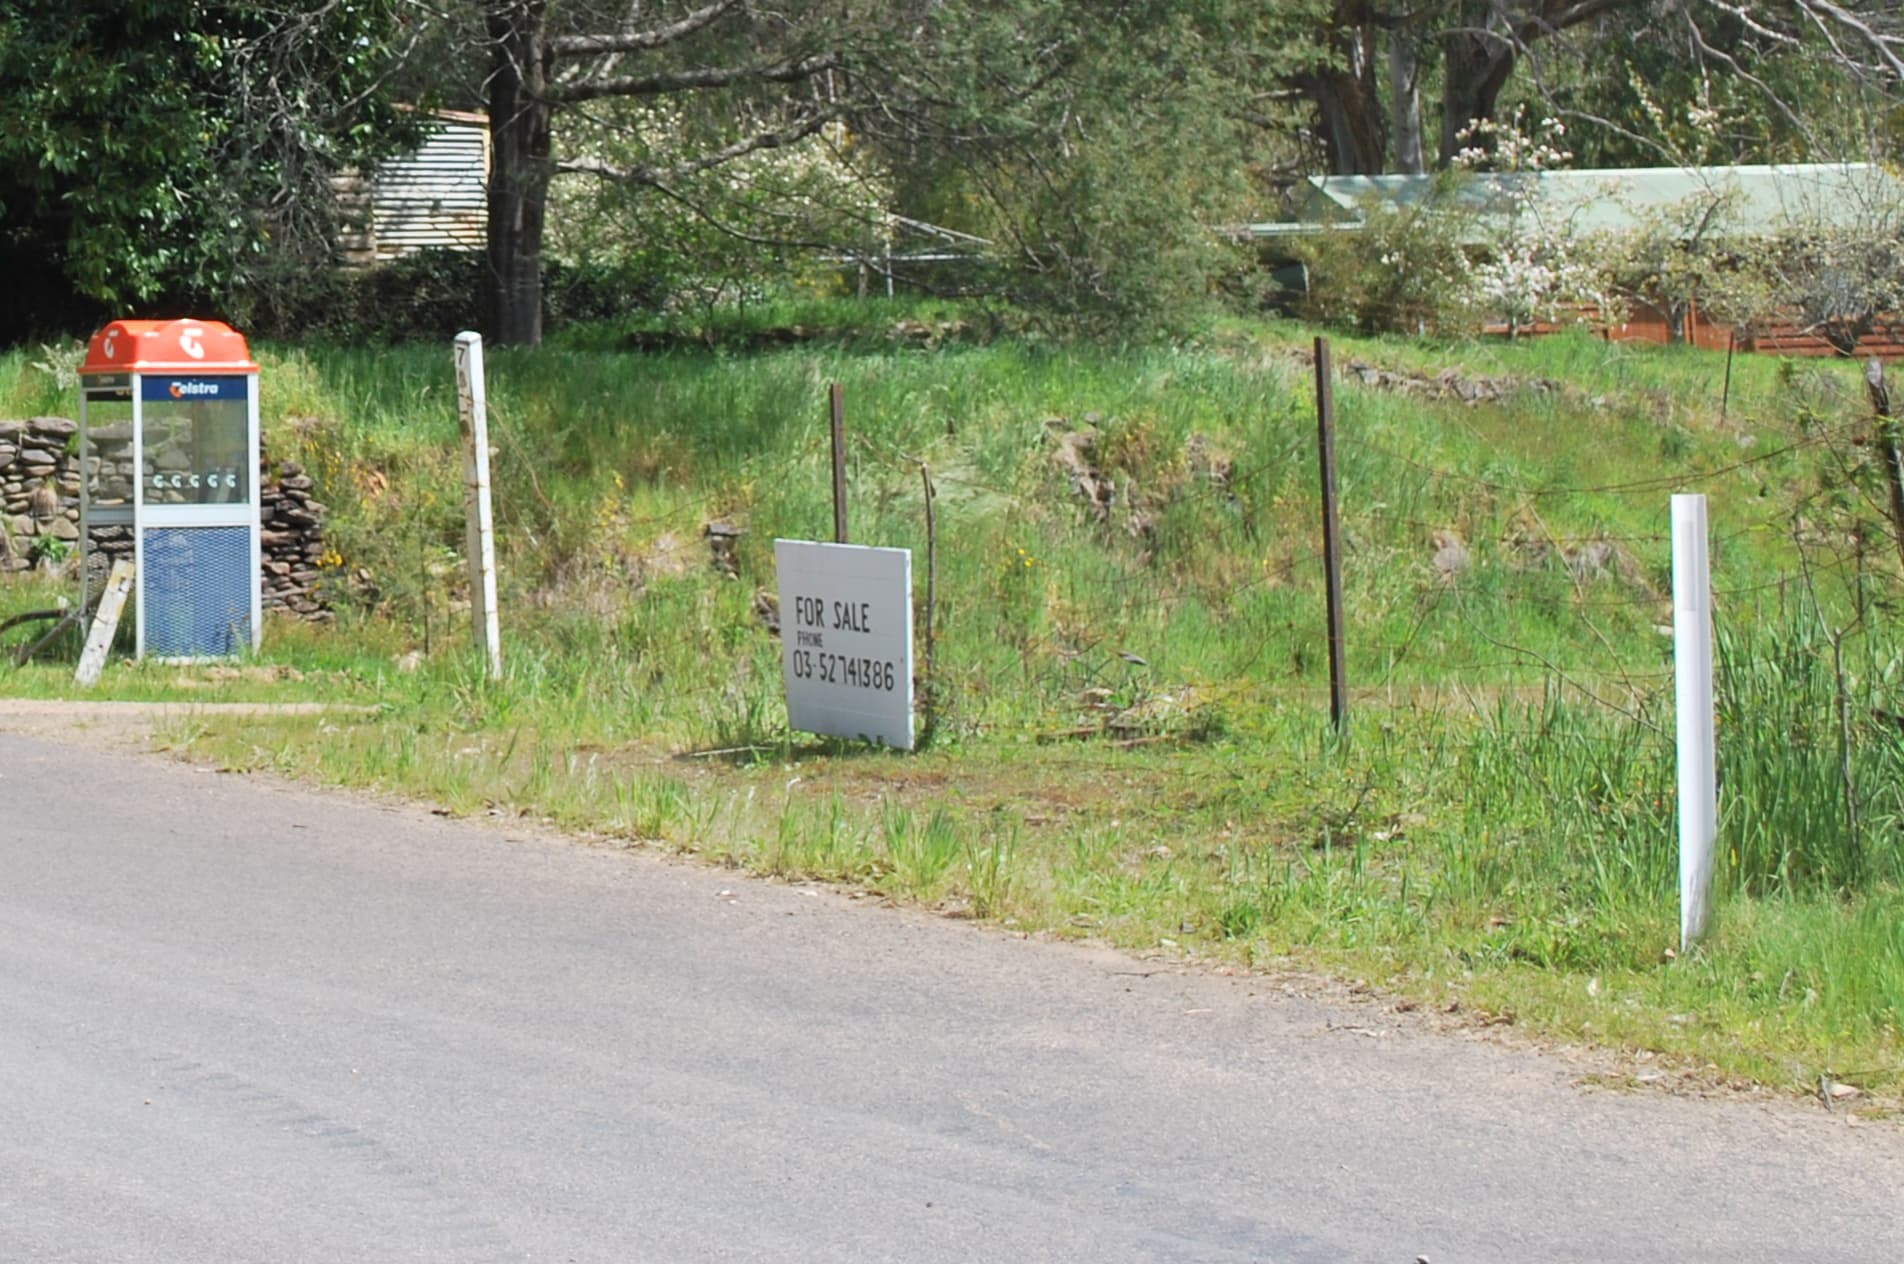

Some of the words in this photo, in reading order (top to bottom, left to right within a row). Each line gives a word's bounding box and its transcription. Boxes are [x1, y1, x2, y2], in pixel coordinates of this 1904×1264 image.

[169, 382, 218, 398] Telstra
[796, 596, 824, 628] FOR
[833, 601, 870, 633] SALE
[797, 631, 823, 648] PHONE
